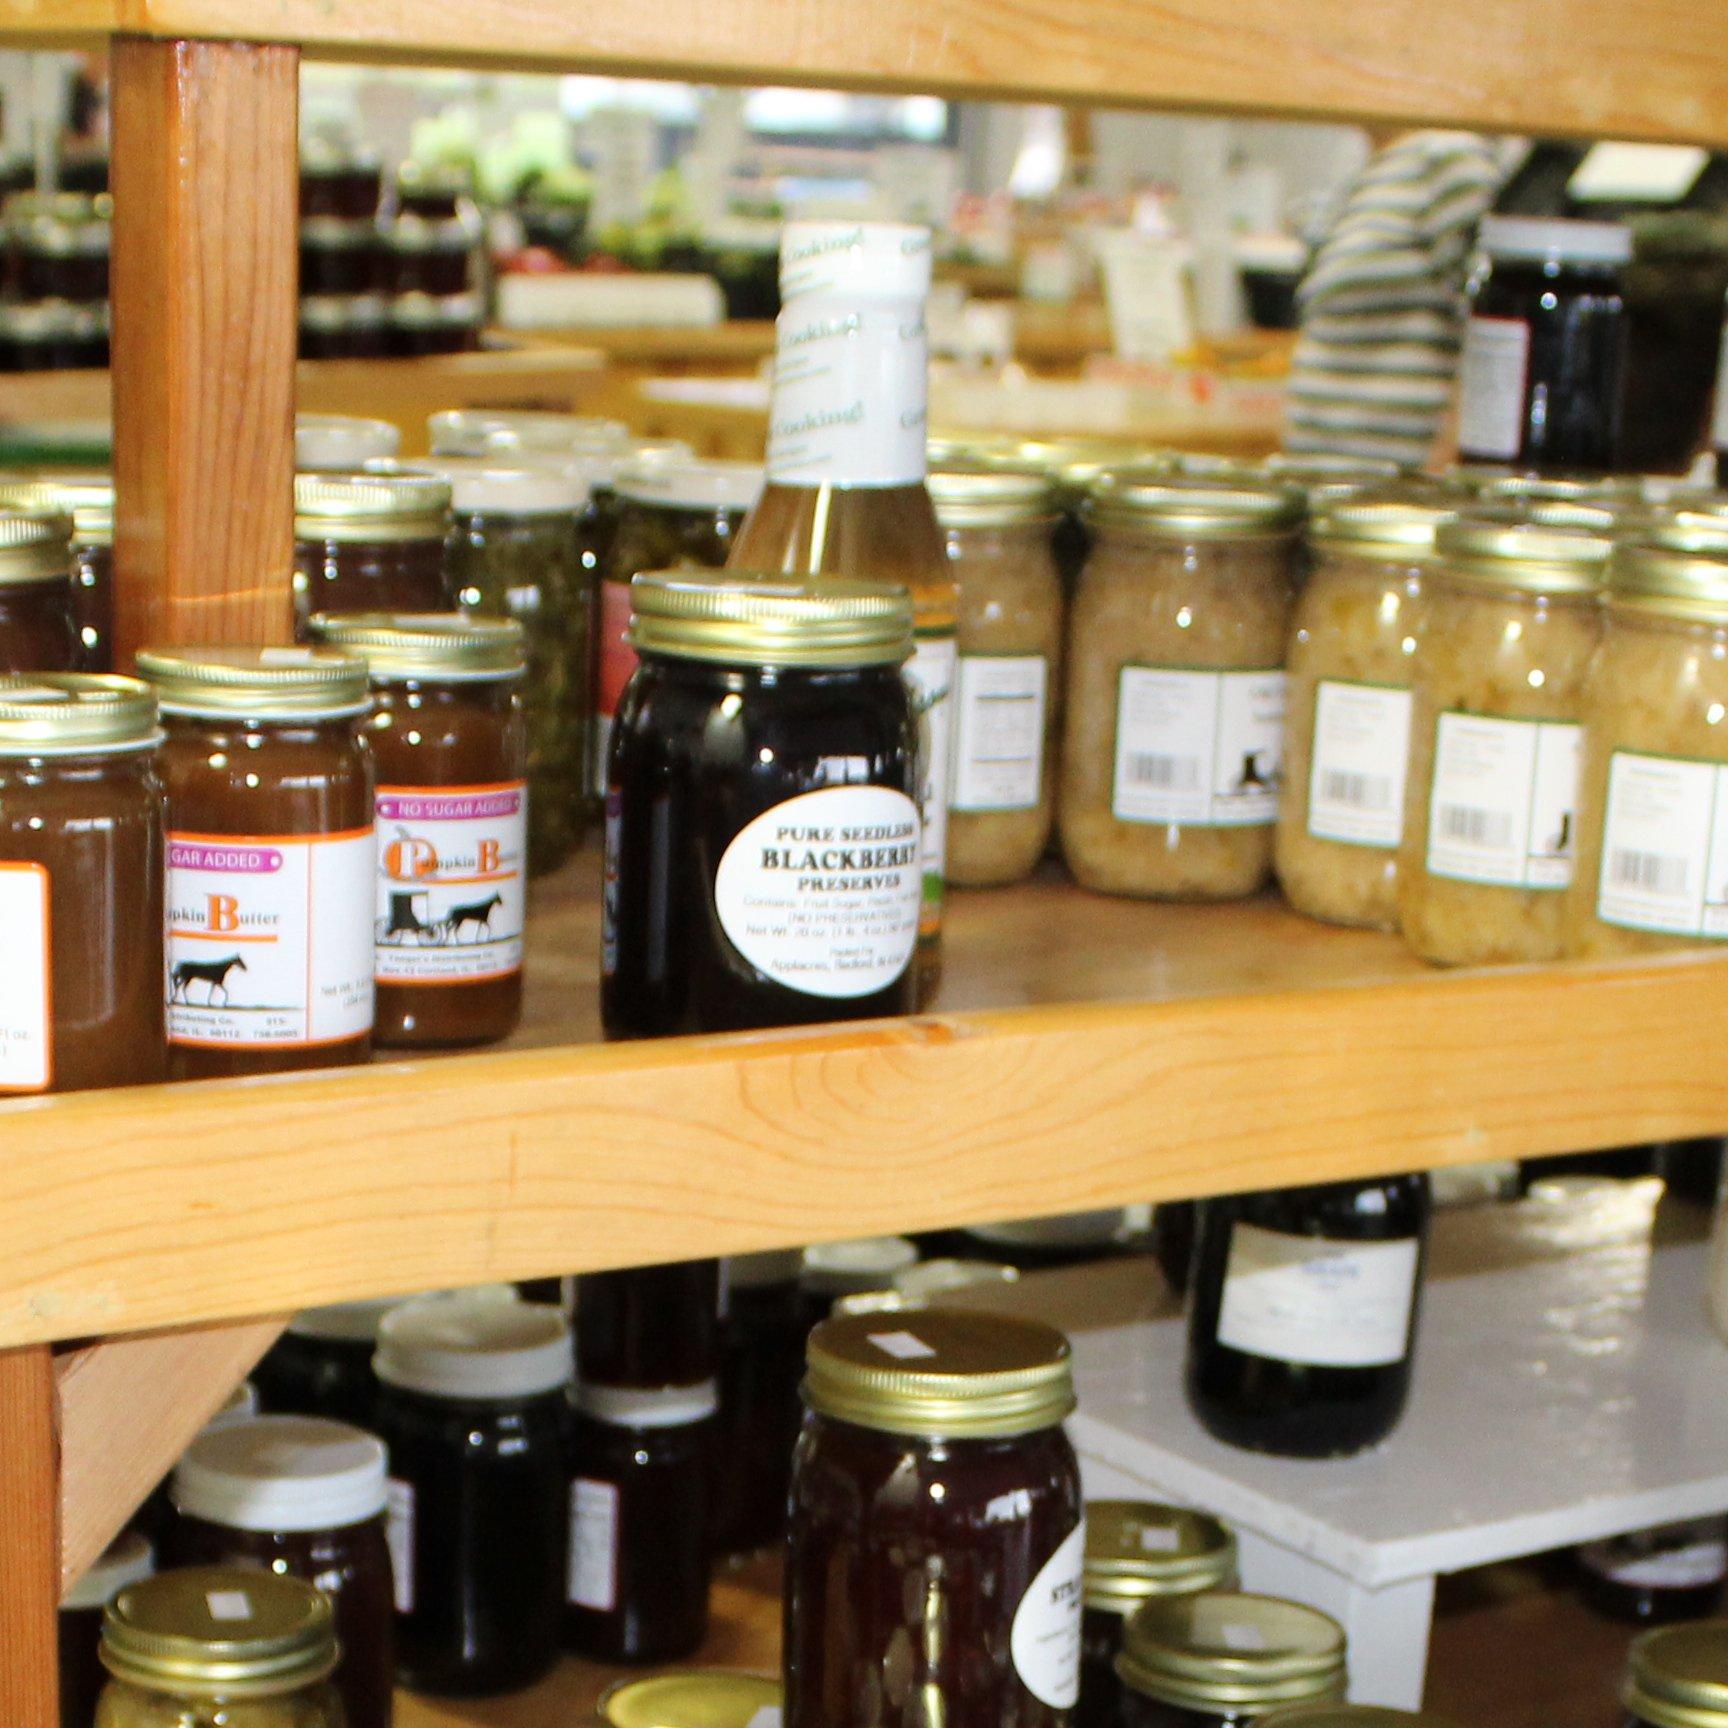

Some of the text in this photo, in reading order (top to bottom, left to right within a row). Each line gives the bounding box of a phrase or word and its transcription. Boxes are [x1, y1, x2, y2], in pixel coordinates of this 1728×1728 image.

[398, 800, 472, 817] NO SUGAR
[776, 826, 835, 842] PURE
[170, 847, 261, 870] GAR ADDED
[205, 893, 280, 933] Butter
